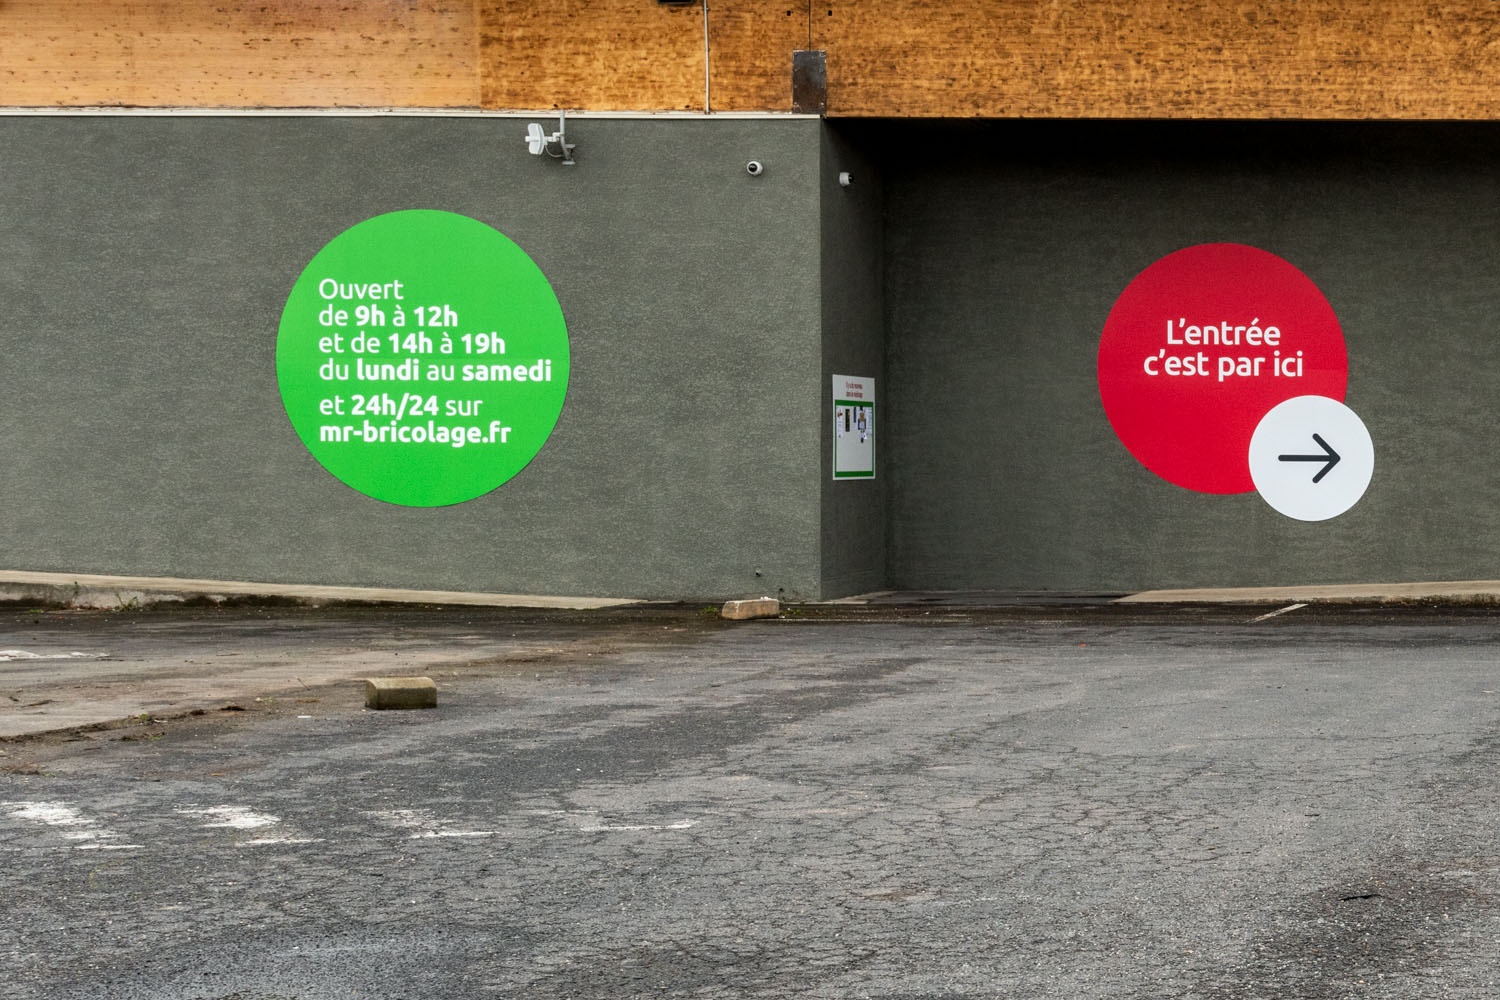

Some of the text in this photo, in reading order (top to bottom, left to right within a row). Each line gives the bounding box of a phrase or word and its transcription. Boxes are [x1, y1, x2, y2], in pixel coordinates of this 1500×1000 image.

[319, 278, 403, 299] Ouvert
[319, 304, 458, 326] de 9h à 12h
[319, 331, 505, 354] et de 14h à 19h
[1167, 318, 1280, 346] L’entrée
[320, 358, 551, 381] du lundi au samedi
[1144, 349, 1302, 382] c’est par ici
[320, 393, 483, 420] et 24h/24 sur
[320, 420, 511, 447] mr-bricolage.fr
